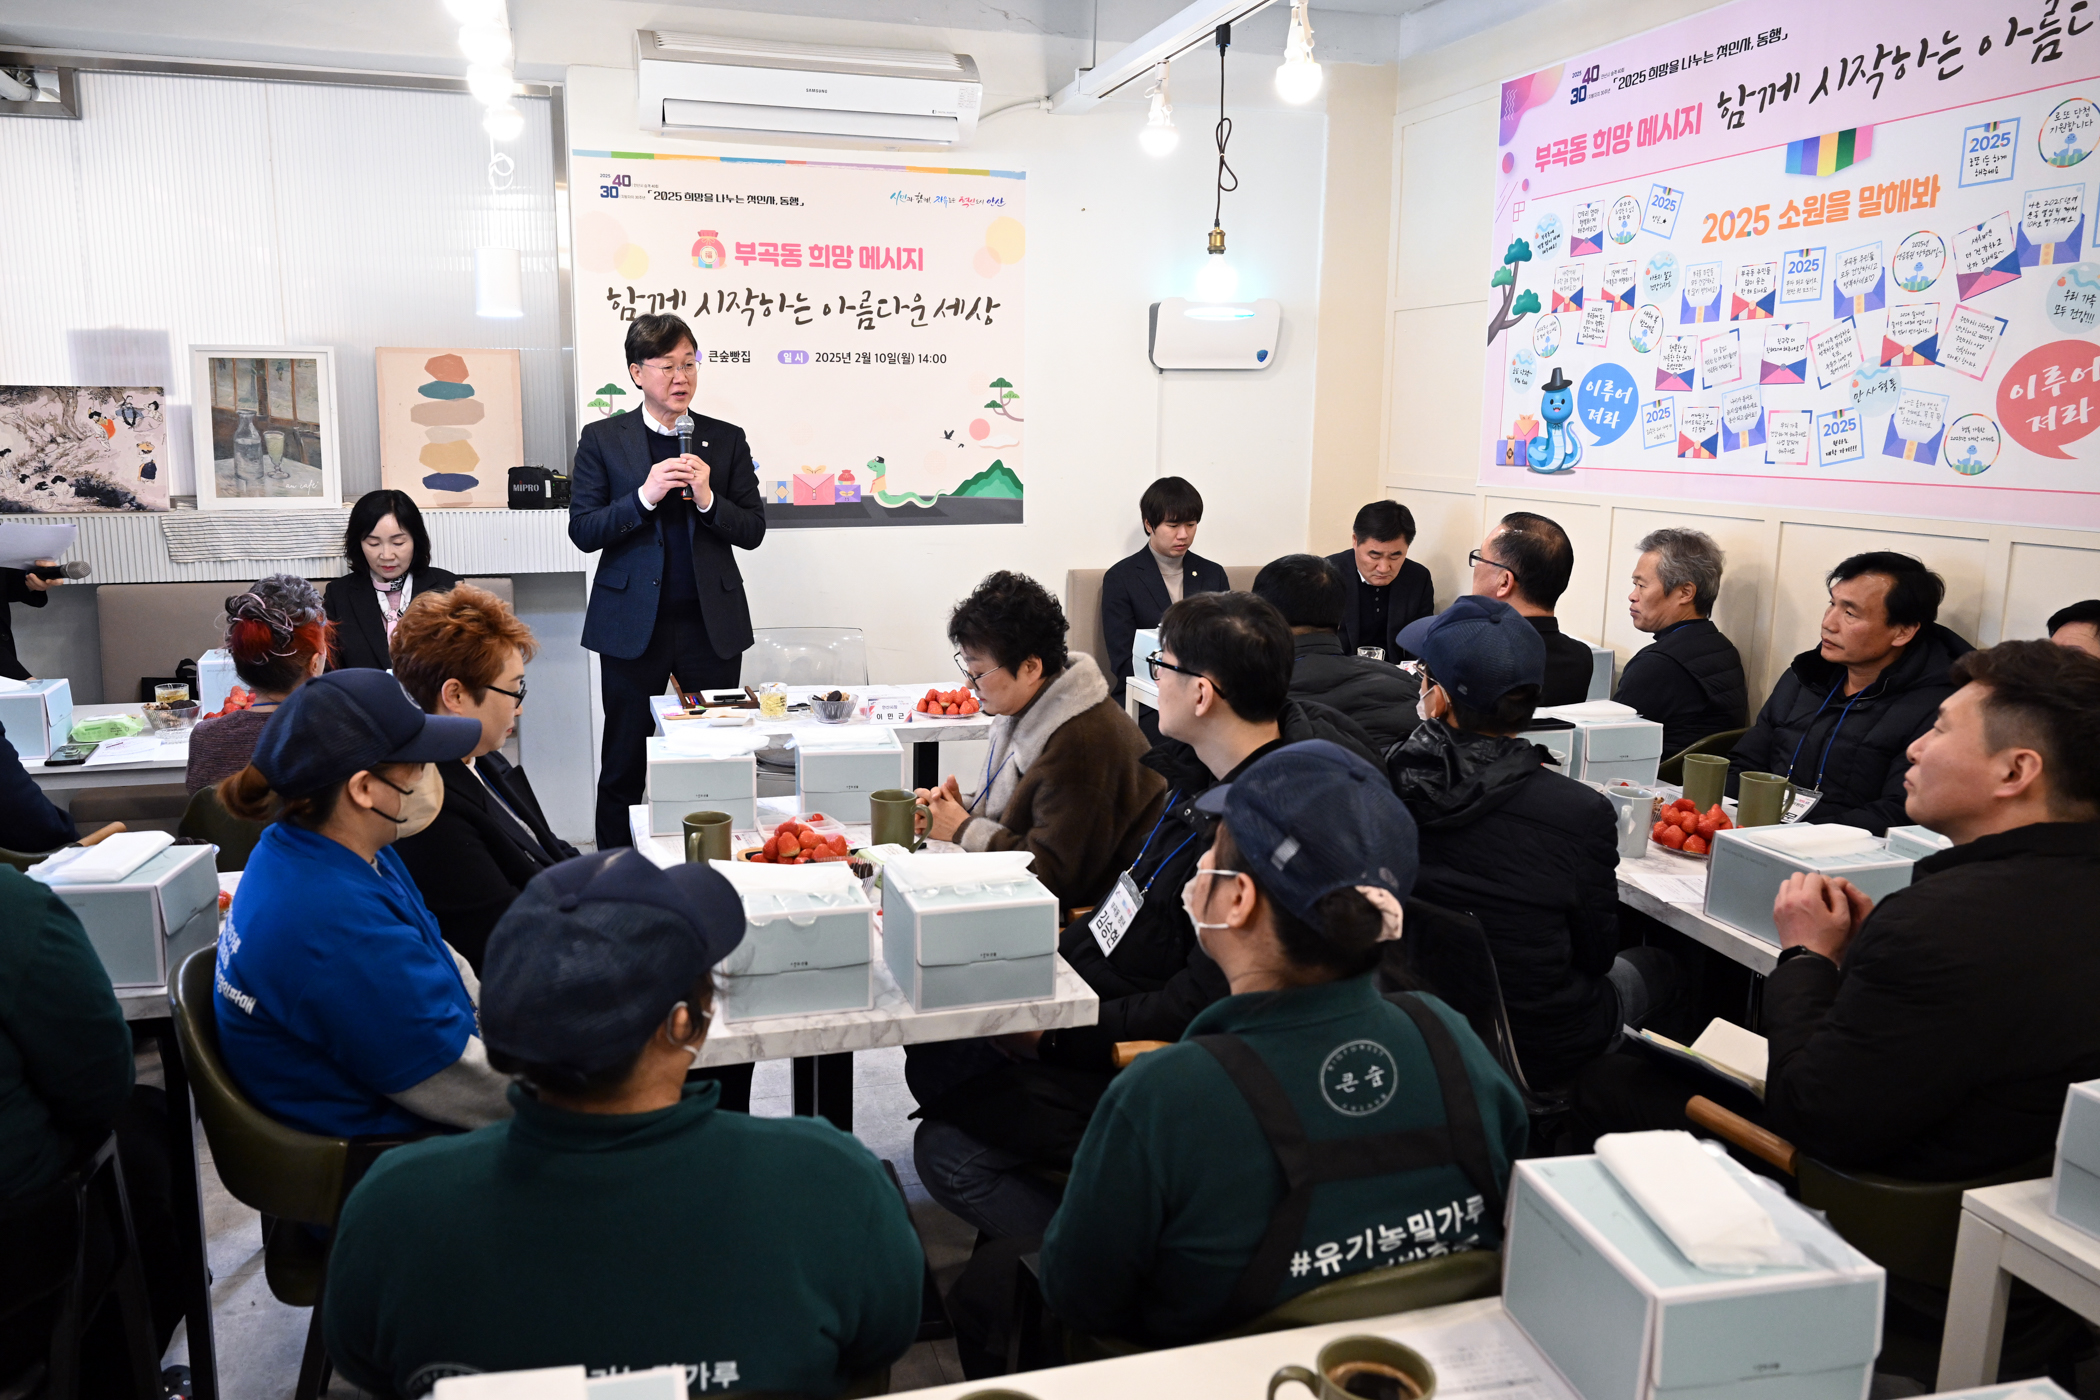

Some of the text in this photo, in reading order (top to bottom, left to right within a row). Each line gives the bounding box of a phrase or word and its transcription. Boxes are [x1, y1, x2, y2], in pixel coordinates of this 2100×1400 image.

[1582, 64, 1600, 85] 40
[1648, 59, 1679, 81] 희망을
[1681, 50, 1714, 71] 나누는
[1717, 71, 1801, 131] 함께
[1809, 31, 1965, 105] 시작하는
[1570, 84, 1587, 105] 30
[2074, 106, 2091, 119] 당첨
[1534, 101, 1704, 173] 부곡동 희망 메시지
[2050, 119, 2094, 134] 기원합니다
[1969, 131, 2011, 153] 2025
[612, 174, 632, 187] 40
[600, 185, 619, 199] 30
[684, 191, 714, 203] 희망을
[716, 193, 744, 203] 나누는
[986, 197, 1007, 207] 안산
[1651, 194, 1677, 212] 2025
[1701, 174, 1941, 244] 2025 소원을 말해봐
[735, 241, 924, 271] 부곡동 희망 메시지
[1788, 258, 1820, 274] 2025
[606, 285, 1001, 330] 함께 시작하는 아름다운 세상
[708, 350, 751, 364] 큰숲빵집
[815, 351, 947, 366] 2025년 2월 10일(월) 14:00
[2009, 356, 2100, 401] 이루어
[1585, 379, 1633, 405] 이루어
[1587, 407, 1621, 429] 져라
[1646, 406, 1671, 424] 2025
[2025, 397, 2095, 433] 져라
[1823, 418, 1857, 437] 2025
[513, 482, 540, 492] MIPRO
[1096, 910, 1120, 949] 김승현
[1290, 1194, 1486, 1278] #유기농밀가루
